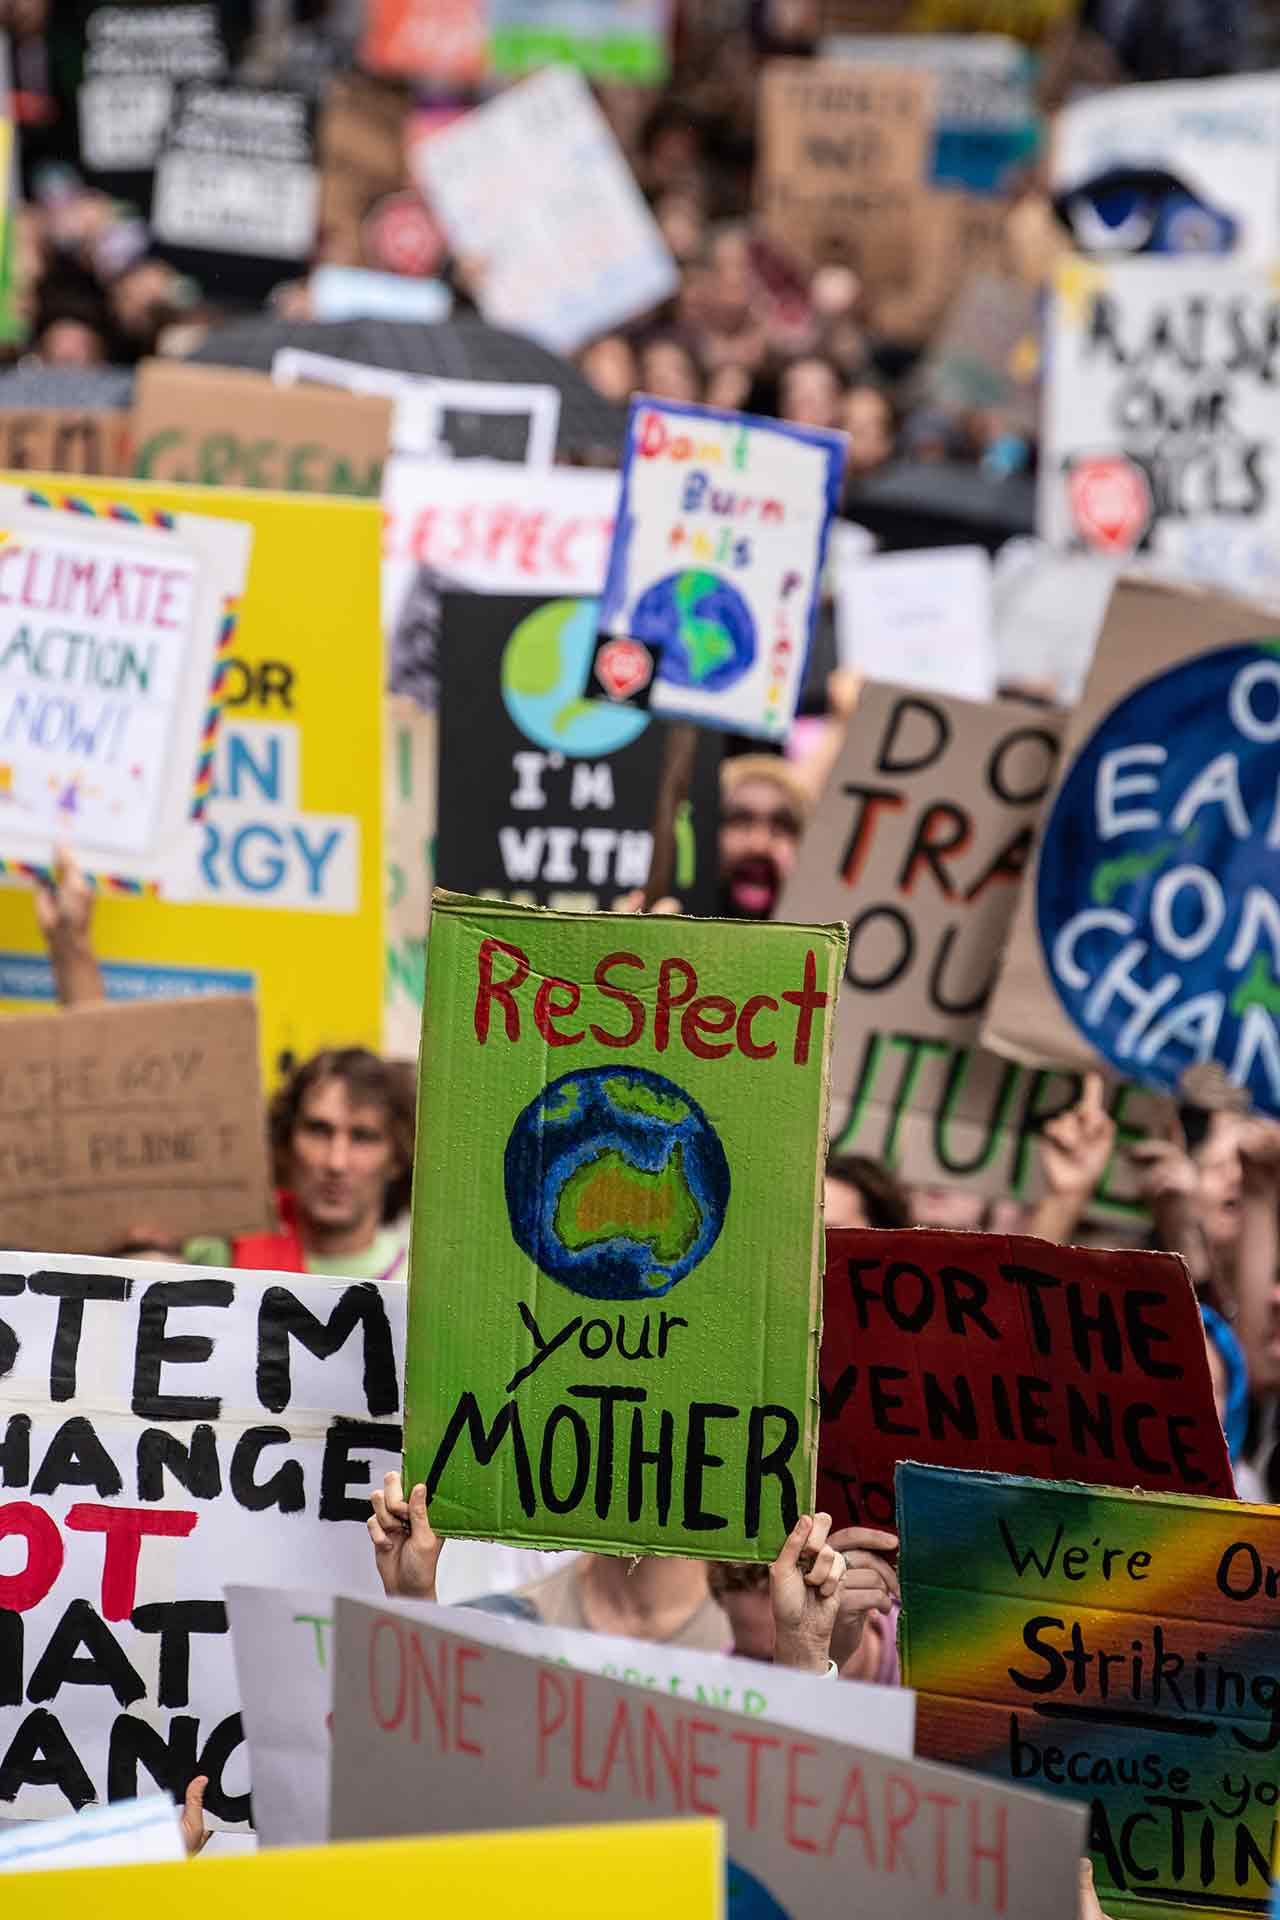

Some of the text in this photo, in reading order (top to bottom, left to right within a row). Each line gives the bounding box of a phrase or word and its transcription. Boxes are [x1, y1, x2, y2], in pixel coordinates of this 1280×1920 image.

[0, 625, 156, 693] ACTION
[206, 733, 282, 805] N
[1094, 743, 1280, 850] EA
[498, 826, 655, 888] WITH
[0, 1270, 400, 1422] TEM
[506, 1301, 690, 1393] your
[848, 1257, 1186, 1380] FOR THE
[425, 1385, 801, 1540] MOTHER
[0, 1501, 199, 1622] OT
[1000, 1518, 1153, 1581] We're
[368, 1616, 486, 1757] ONE
[1007, 1615, 1280, 1752] Striking
[1010, 1711, 1192, 1794] because
